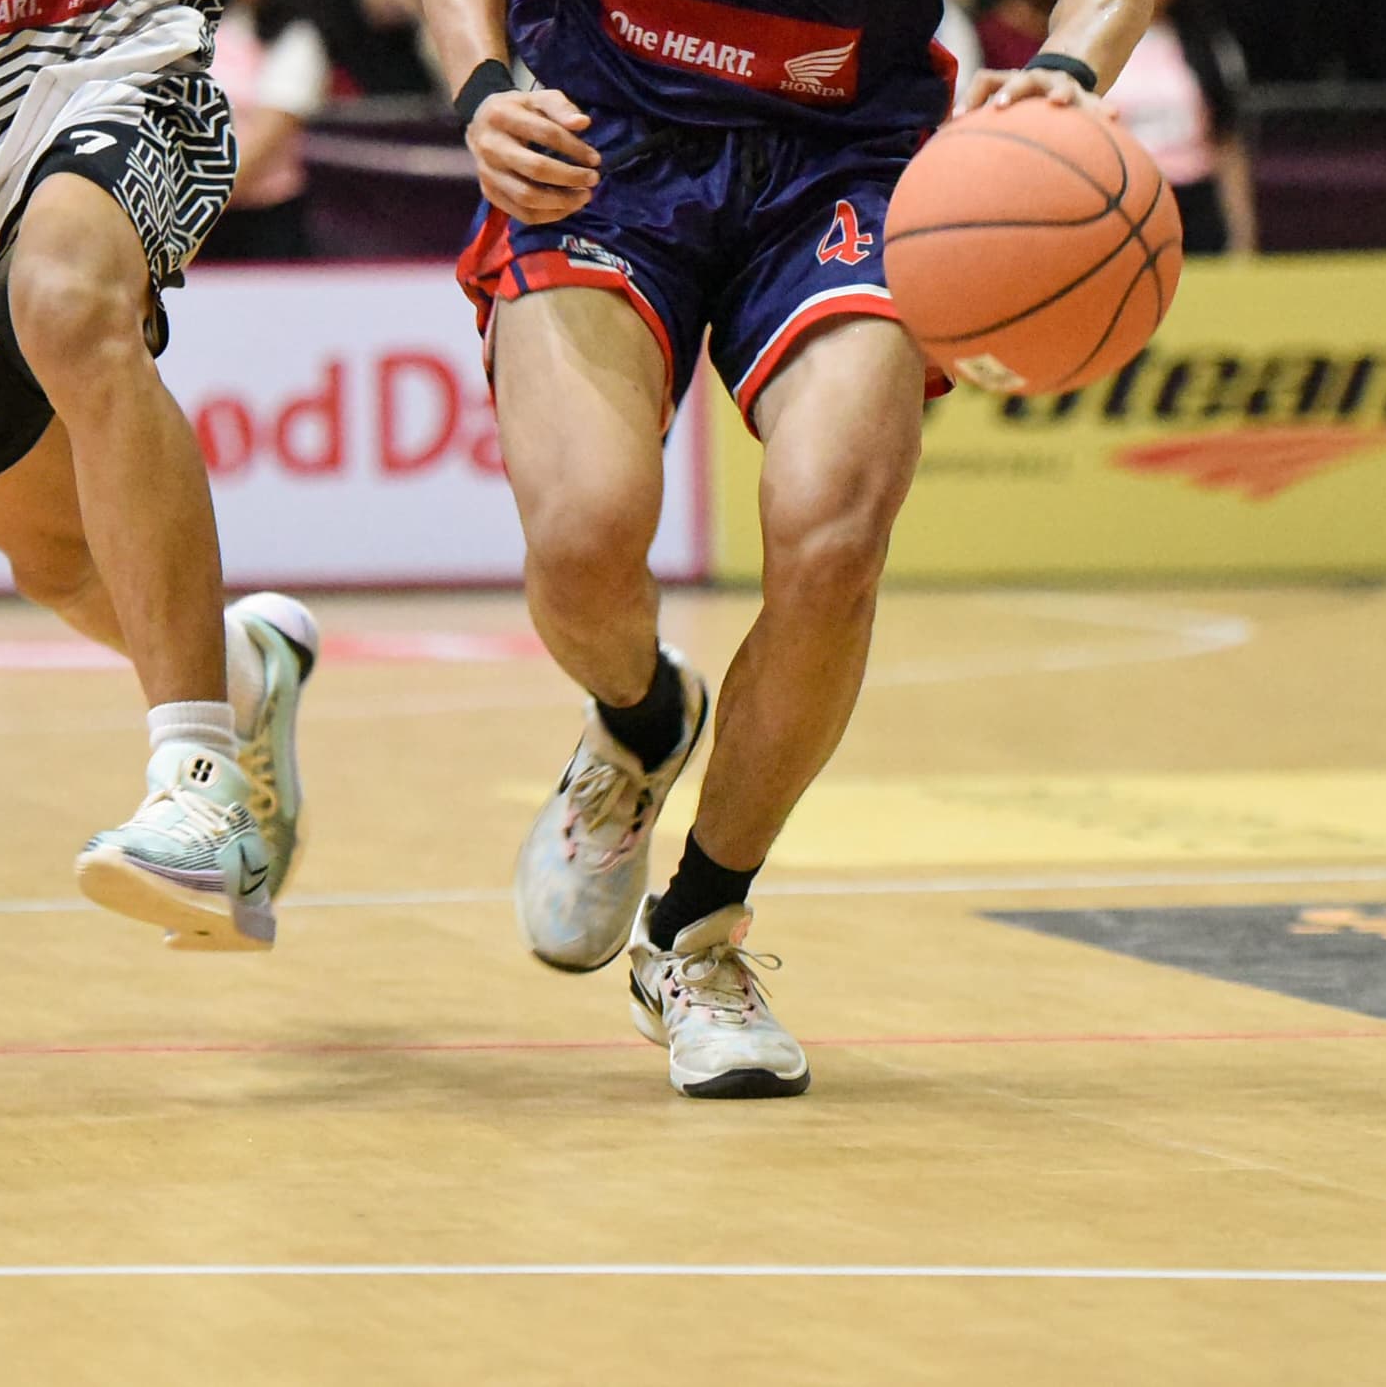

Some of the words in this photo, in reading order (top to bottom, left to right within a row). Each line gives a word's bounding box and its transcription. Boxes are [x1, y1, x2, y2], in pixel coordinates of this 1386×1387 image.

[610, 10, 659, 50] One
[662, 30, 755, 77] HEART.
[780, 79, 846, 97] HONDA
[816, 199, 873, 266] 4
